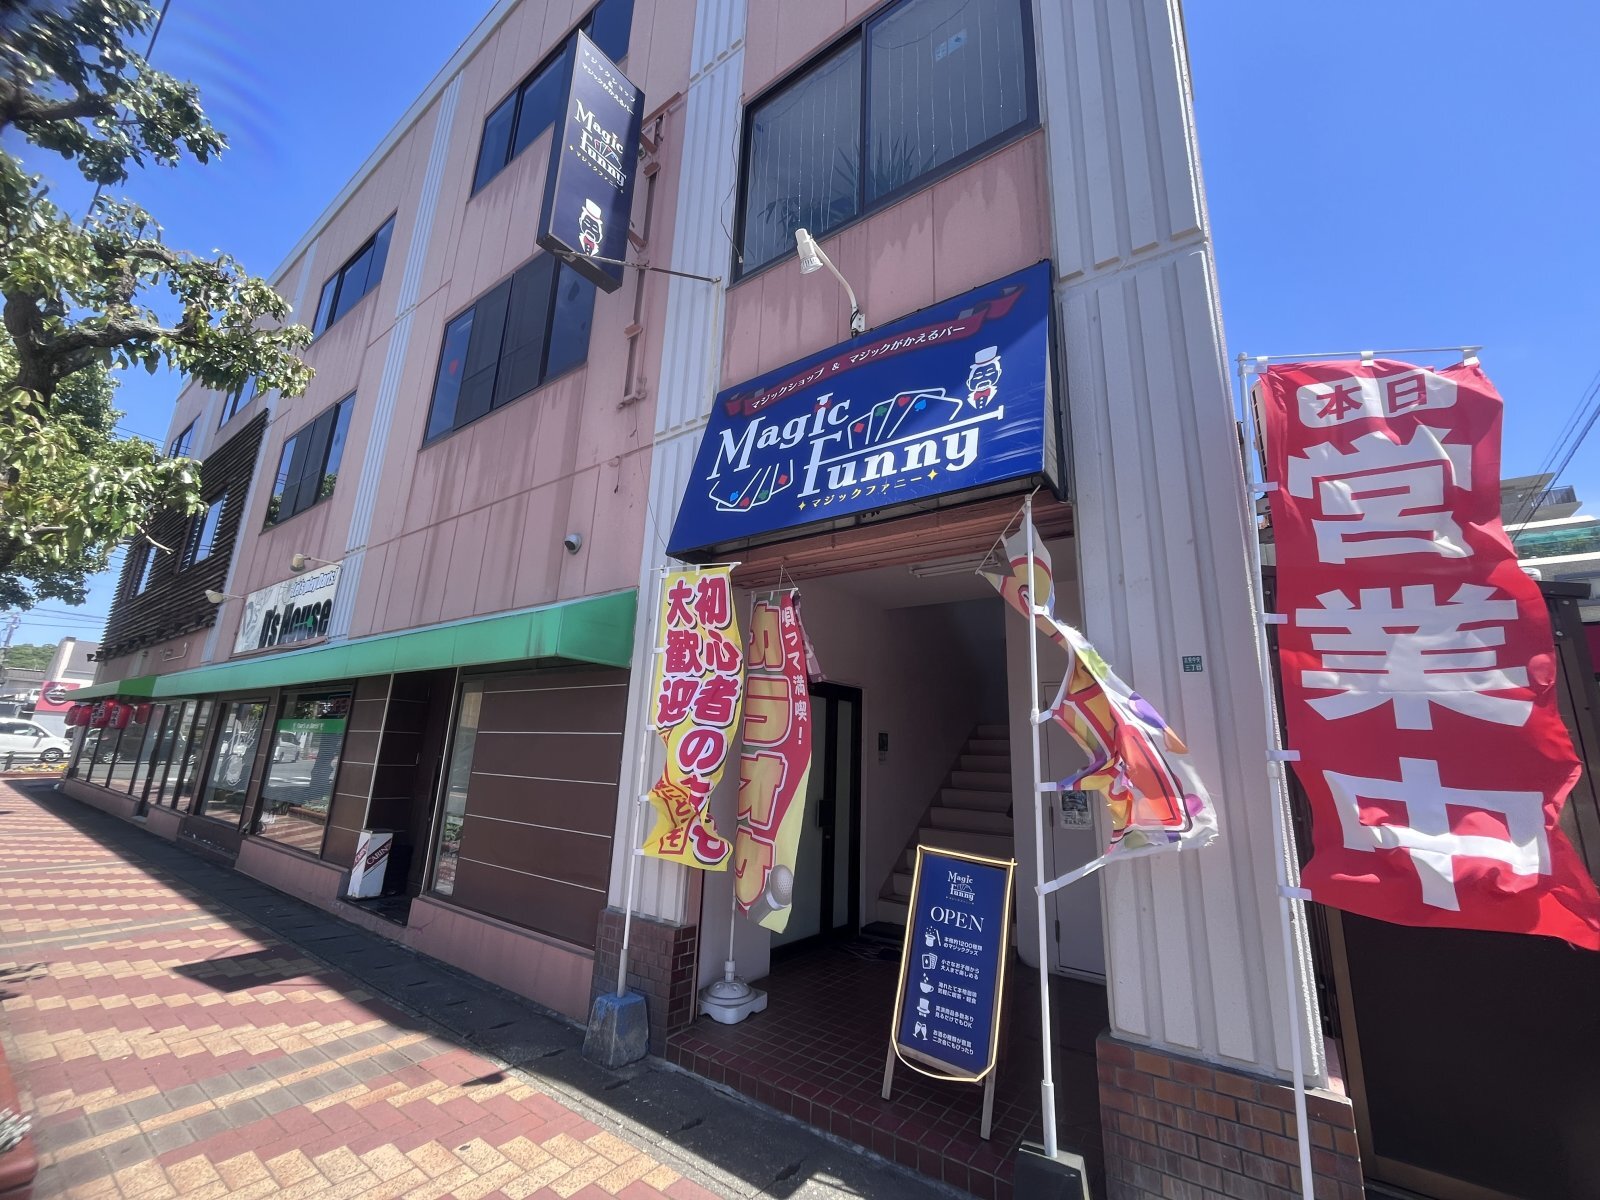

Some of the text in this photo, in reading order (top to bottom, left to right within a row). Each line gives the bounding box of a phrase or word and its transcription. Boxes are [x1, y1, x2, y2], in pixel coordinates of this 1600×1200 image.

[574, 99, 624, 154] Magic
[580, 129, 627, 187] Funny
[751, 326, 966, 409] マジックショップ & マジックがかえるバー
[1316, 374, 1428, 421] 本日
[706, 392, 851, 481] Magic
[797, 405, 1005, 499] Funny
[811, 476, 923, 508] マジックファニー
[277, 598, 333, 646] House
[656, 579, 702, 727] 大歓迎
[1288, 425, 1553, 912] 営業中
[947, 870, 974, 884] Magic
[950, 883, 976, 902] Funny
[930, 906, 985, 933] OPEN
